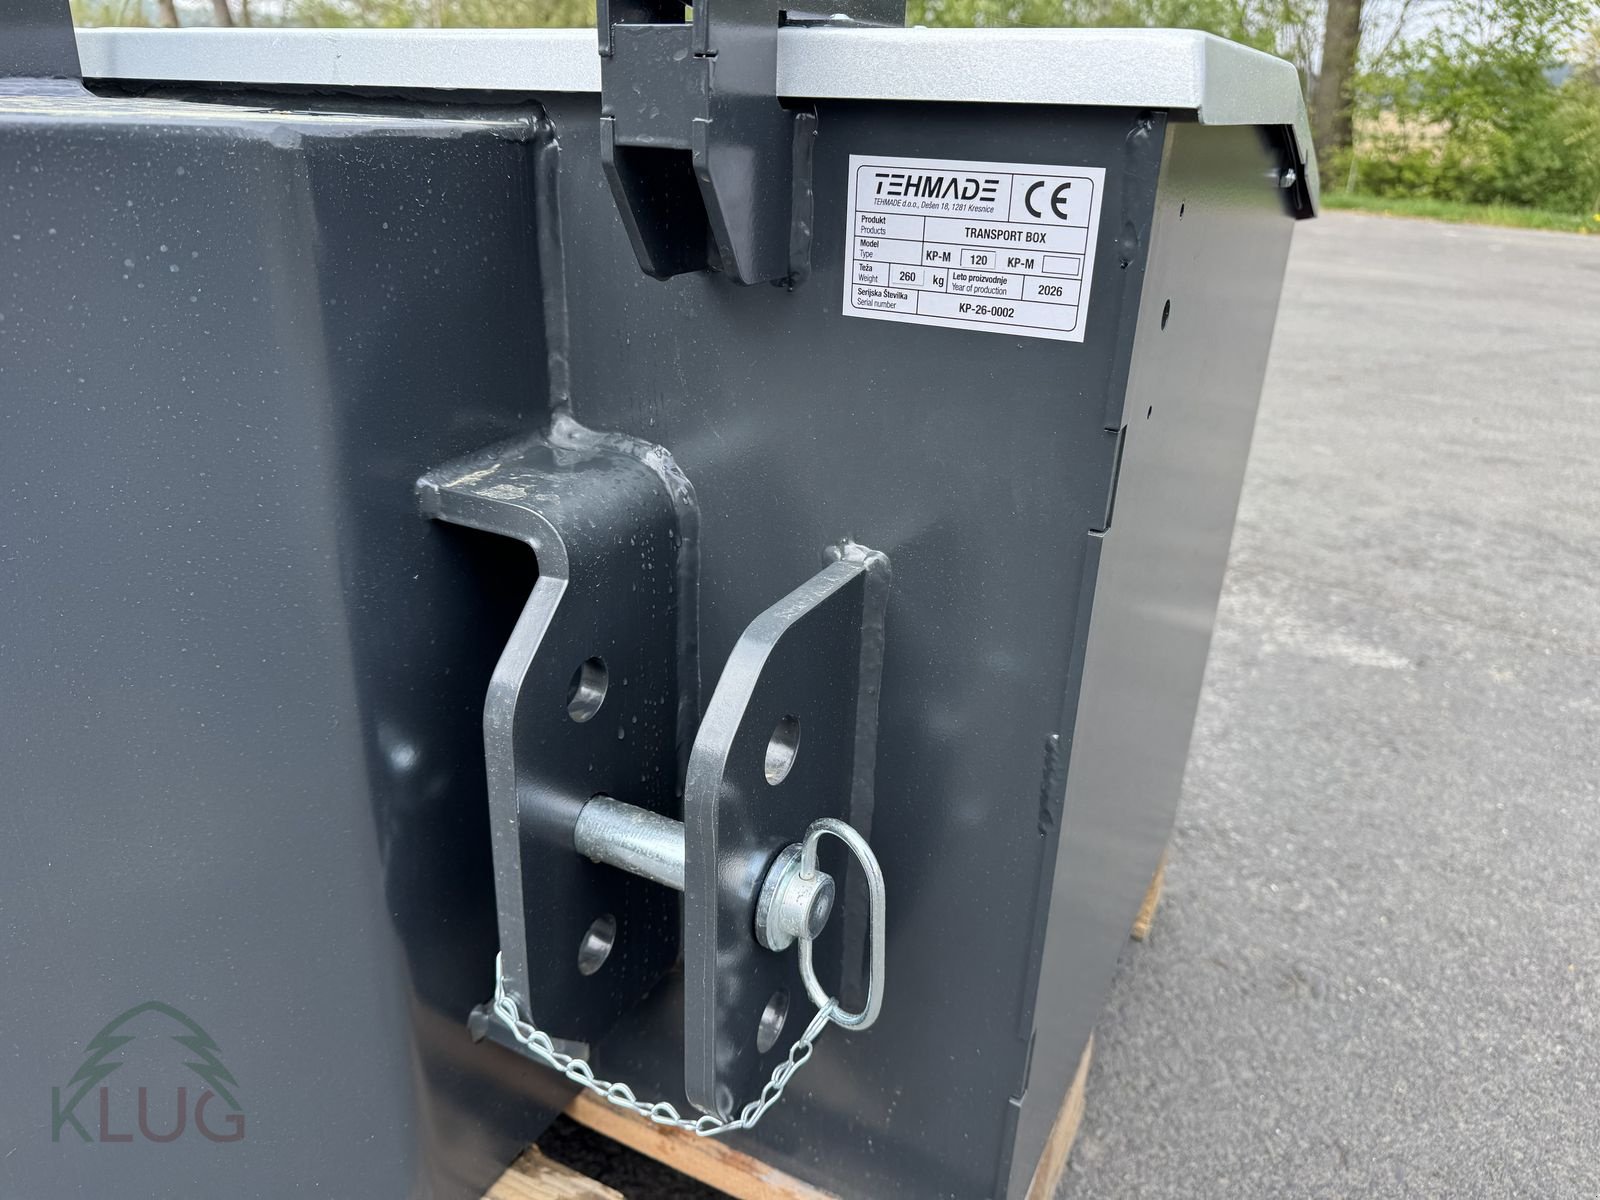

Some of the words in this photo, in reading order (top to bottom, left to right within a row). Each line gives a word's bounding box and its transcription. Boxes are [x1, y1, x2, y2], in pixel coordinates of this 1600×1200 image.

[875, 173, 999, 202] TEHMADE
[873, 198, 901, 207] TEHMADE
[902, 200, 919, 209] d.o.o.,
[921, 201, 939, 210] Dešen
[941, 202, 950, 211] 18,
[952, 203, 966, 212] 1281
[968, 204, 994, 214] Kresnice
[861, 215, 886, 225] Produkt
[860, 225, 886, 235] Products
[965, 227, 1023, 242] TRANSPORT
[1026, 231, 1046, 244] BOX
[860, 239, 879, 248] Model
[860, 249, 873, 258] Type
[926, 250, 951, 262] KP-M
[970, 254, 988, 265] 120
[1007, 257, 1034, 269] KP-M
[859, 263, 873, 272] Teža
[858, 273, 878, 283] Weight
[899, 271, 916, 282] 260
[932, 275, 944, 287] kg
[953, 272, 967, 281] Leto
[968, 274, 1008, 286] proizvodnje
[857, 287, 882, 298] Serijska
[952, 282, 965, 291] Year
[966, 284, 973, 292] of
[973, 285, 1007, 295] production
[1038, 284, 1063, 297] 2026
[857, 298, 873, 307] Serial
[874, 300, 896, 309] number
[959, 302, 1015, 318] KP-26-0002
